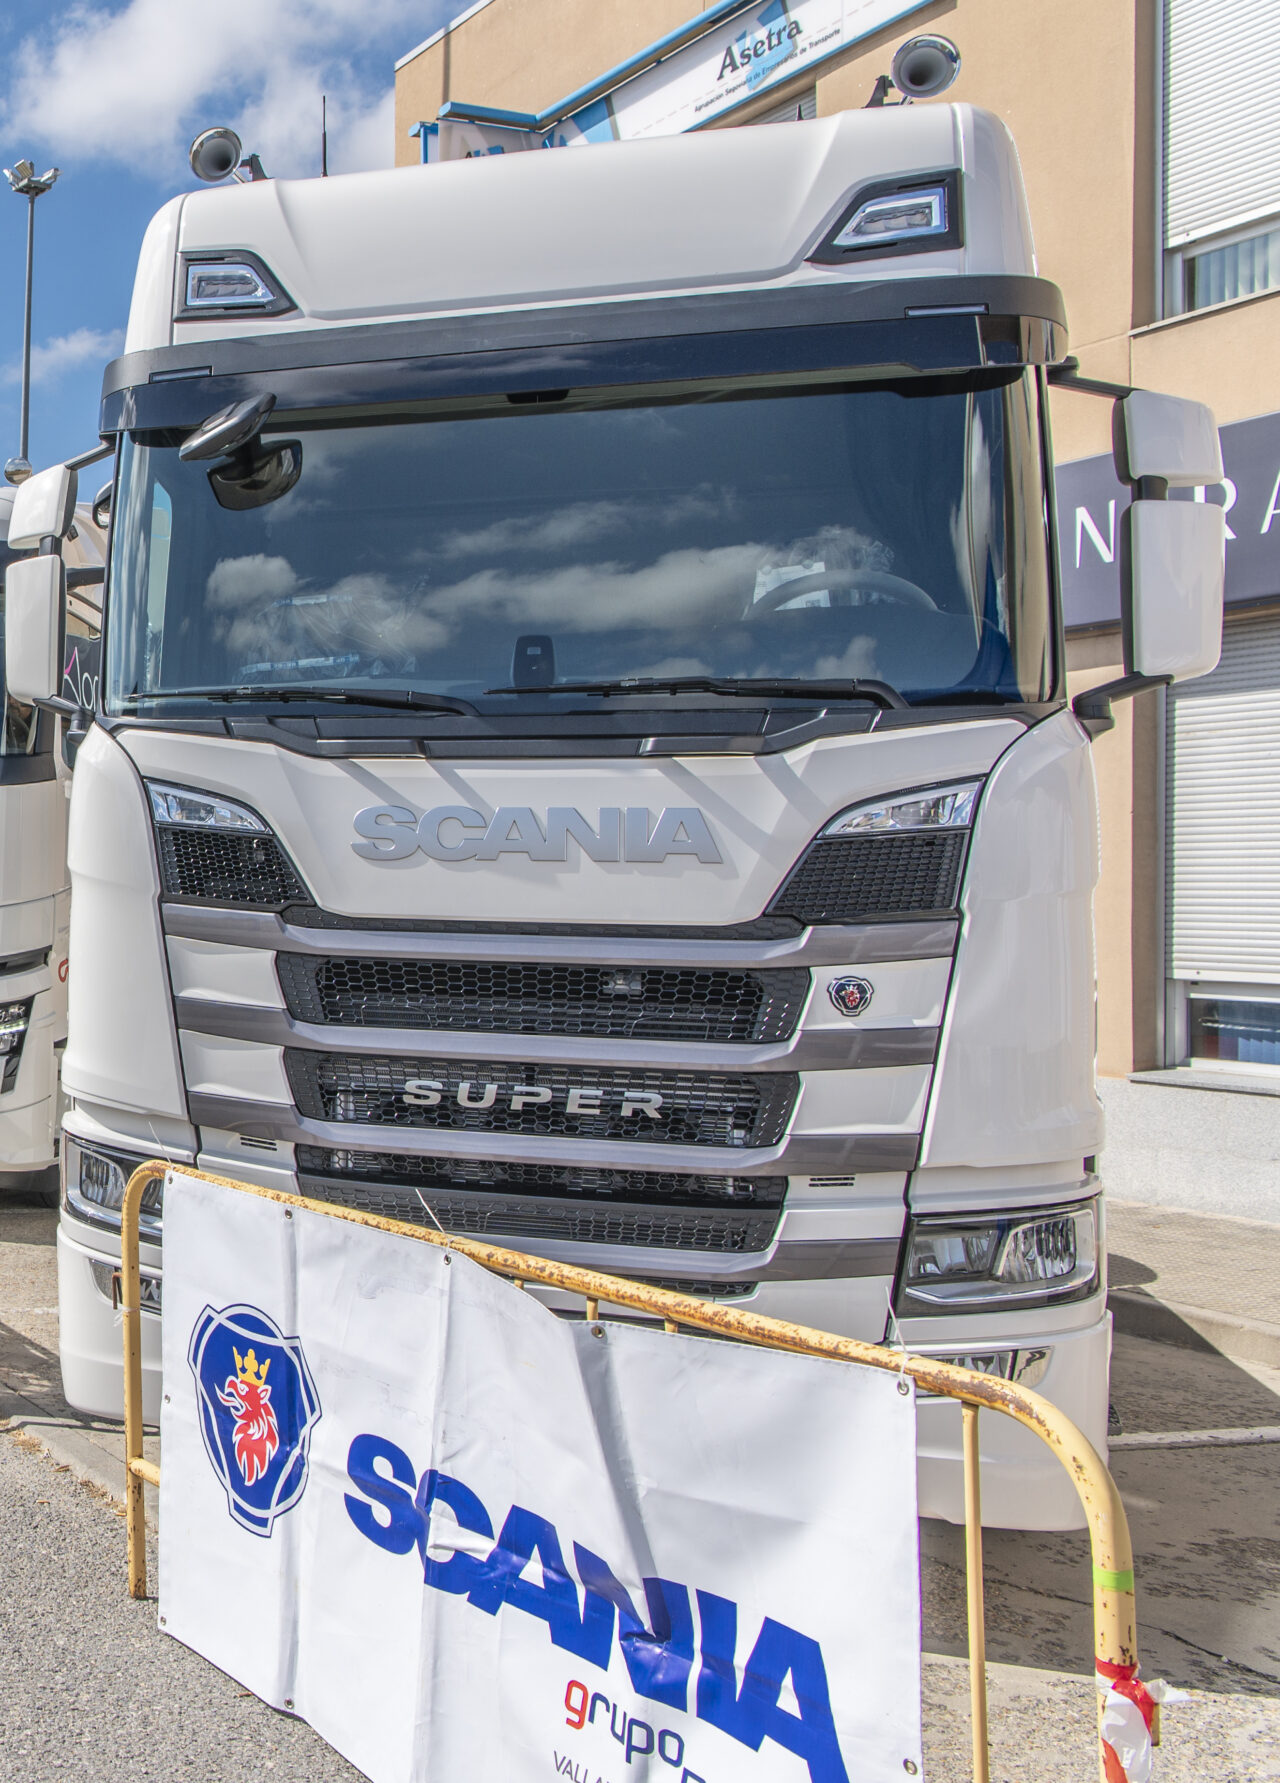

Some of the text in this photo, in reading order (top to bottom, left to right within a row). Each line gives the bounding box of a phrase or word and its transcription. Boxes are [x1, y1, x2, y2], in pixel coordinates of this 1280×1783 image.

[717, 19, 803, 81] Asetra
[799, 46, 807, 55] de
[808, 28, 841, 49] Transporte
[350, 805, 724, 864] SCANIA
[403, 1079, 663, 1119] SUPER
[343, 1433, 852, 1783] SCANIA
[564, 1679, 685, 1768] grupo
